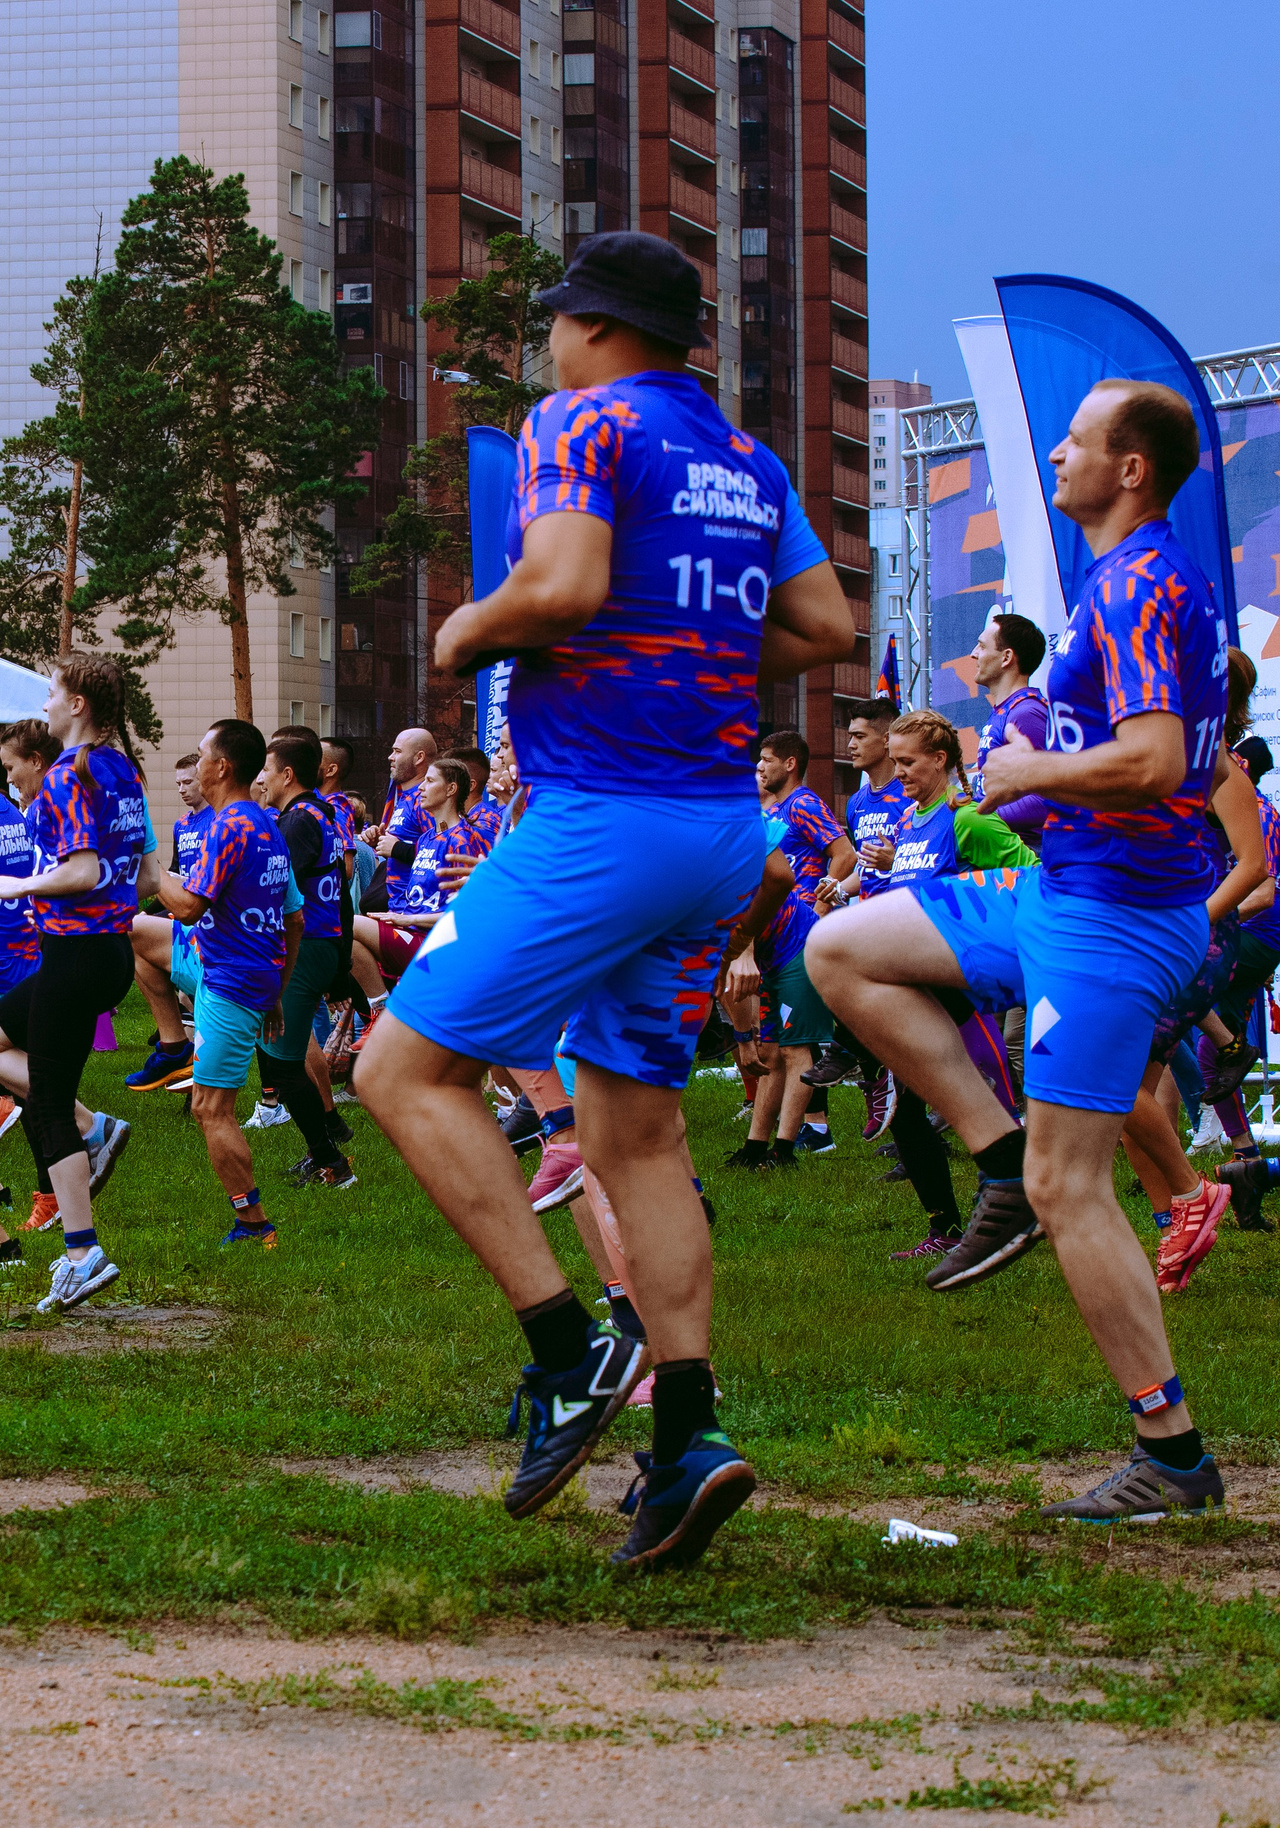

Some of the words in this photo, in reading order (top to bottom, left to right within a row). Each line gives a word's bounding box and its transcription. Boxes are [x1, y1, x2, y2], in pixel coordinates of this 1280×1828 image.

[687, 462, 759, 500] ВРЕМЯ
[668, 554, 771, 621] 11-0
[1192, 717, 1227, 769] 11-
